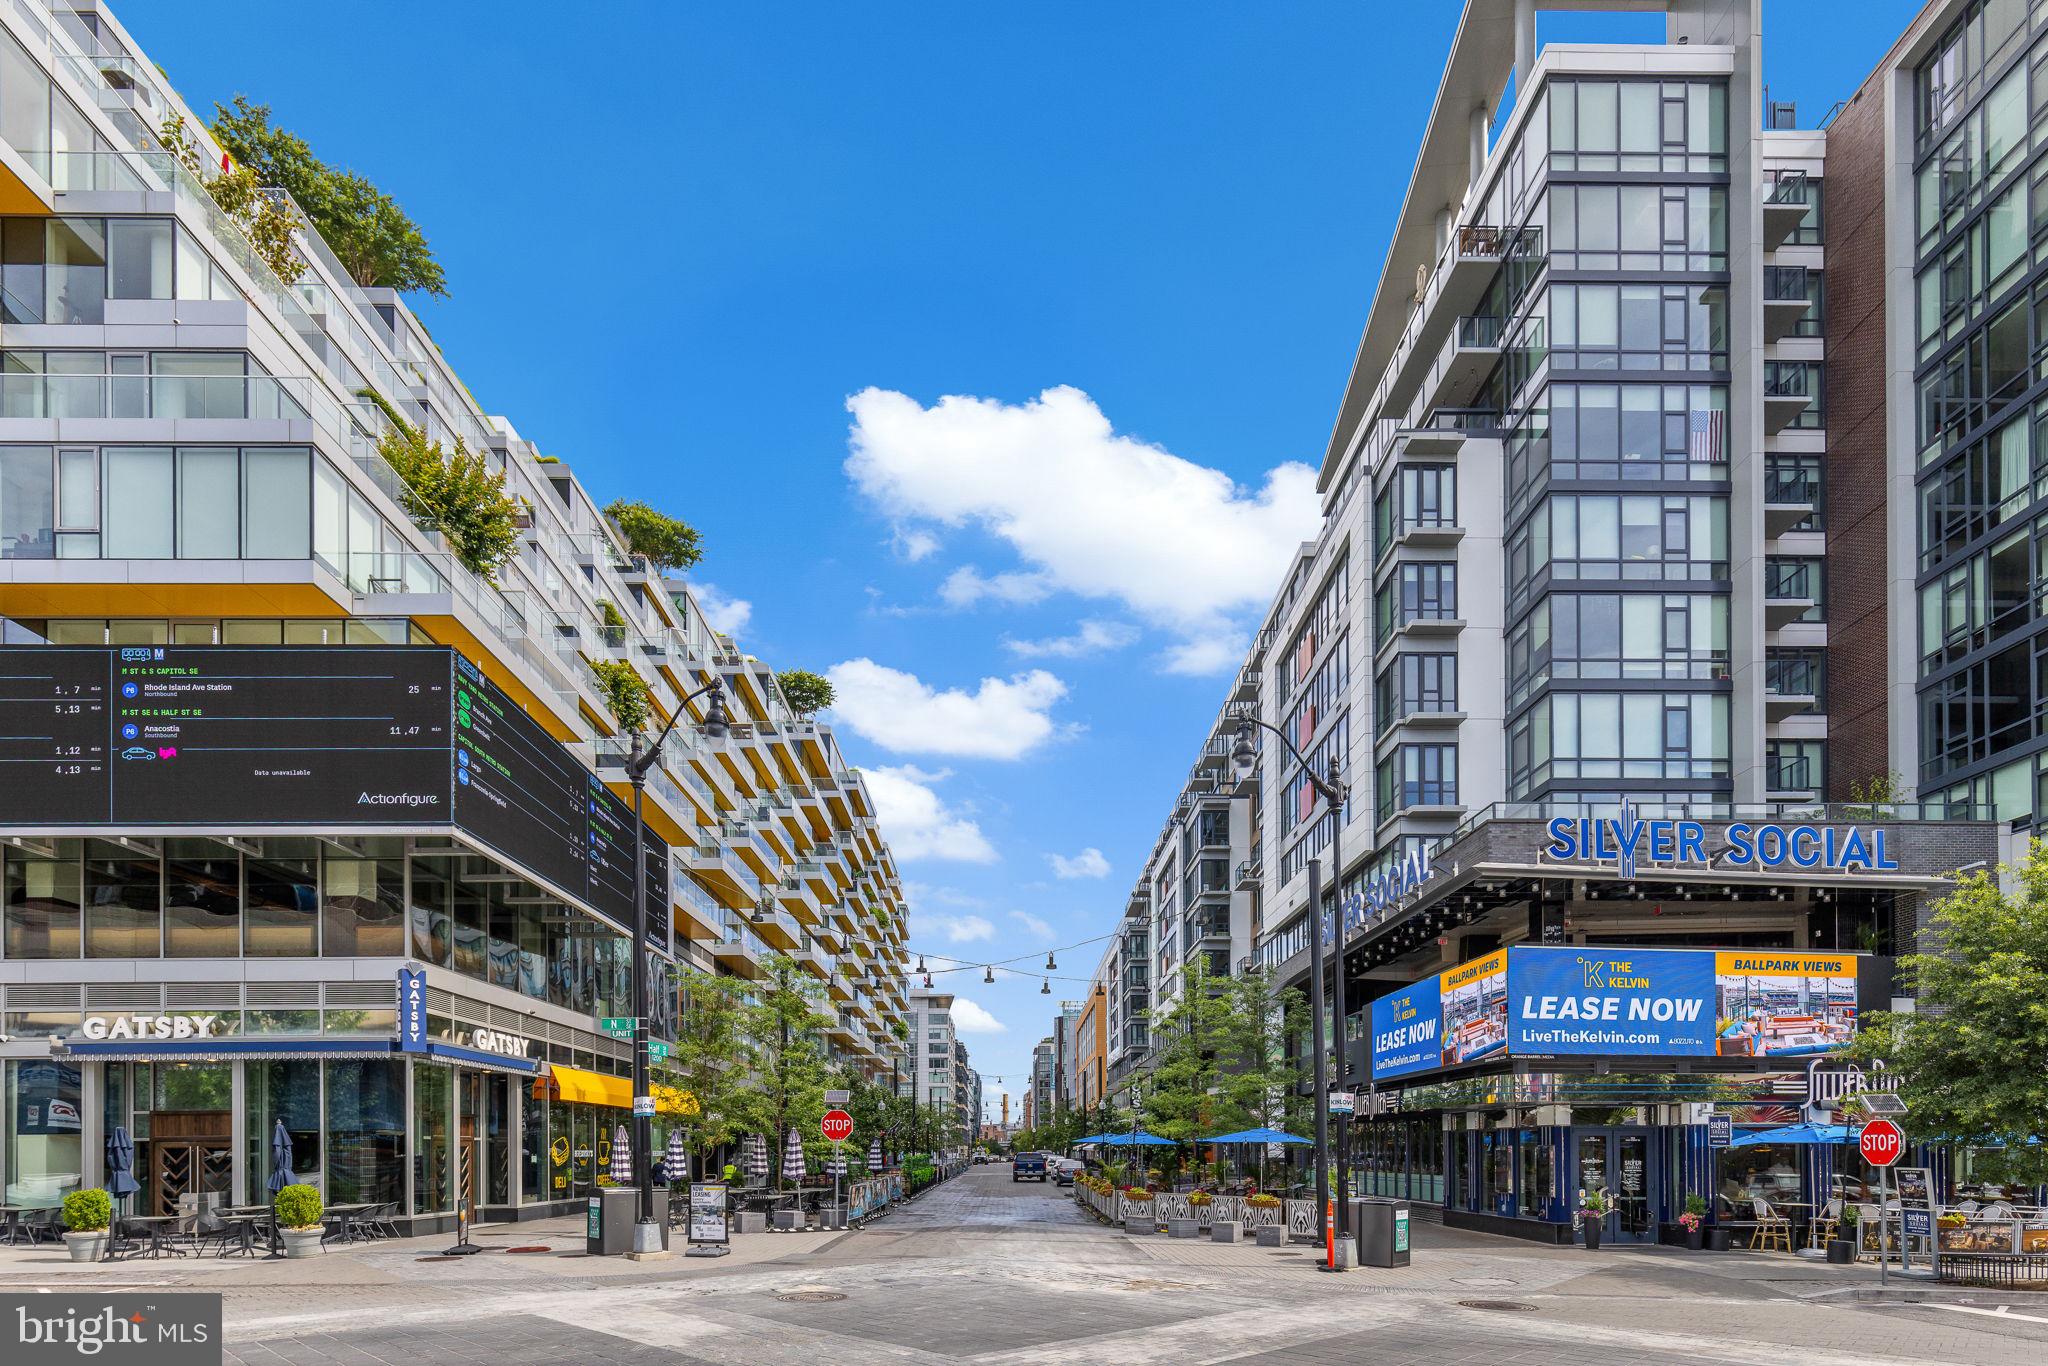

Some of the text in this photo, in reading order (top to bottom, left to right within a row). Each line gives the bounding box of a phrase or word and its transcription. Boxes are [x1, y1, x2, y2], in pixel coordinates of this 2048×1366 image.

[358, 792, 438, 806] Actionfigure
[1546, 808, 1899, 870] SILVER SOCIAL
[1365, 844, 1430, 916] SOCIAL
[1448, 958, 1499, 986] BALLPARK VIEWS
[1610, 962, 1632, 972] THE
[1734, 960, 1842, 972] BALLPARK VIEWS
[1609, 977, 1649, 988] KELVIN
[1402, 997, 1410, 1007] THE
[1522, 996, 1703, 1022] LEASE NOW
[409, 980, 420, 1042] GATSBY
[1402, 1008, 1416, 1020] KELVIN
[82, 1016, 216, 1039] GATSBY
[611, 1020, 617, 1028] N
[1376, 1018, 1436, 1053] LEASE NOW
[1523, 1030, 1659, 1044] LiveTheKelvin.com
[473, 1029, 530, 1057] GATSBY
[648, 1043, 660, 1052] Half
[1376, 1053, 1420, 1070] LiveTheKelvin.com
[824, 1120, 850, 1131] STOP
[1863, 1134, 1896, 1151] STOP
[555, 1176, 566, 1188] DELI
